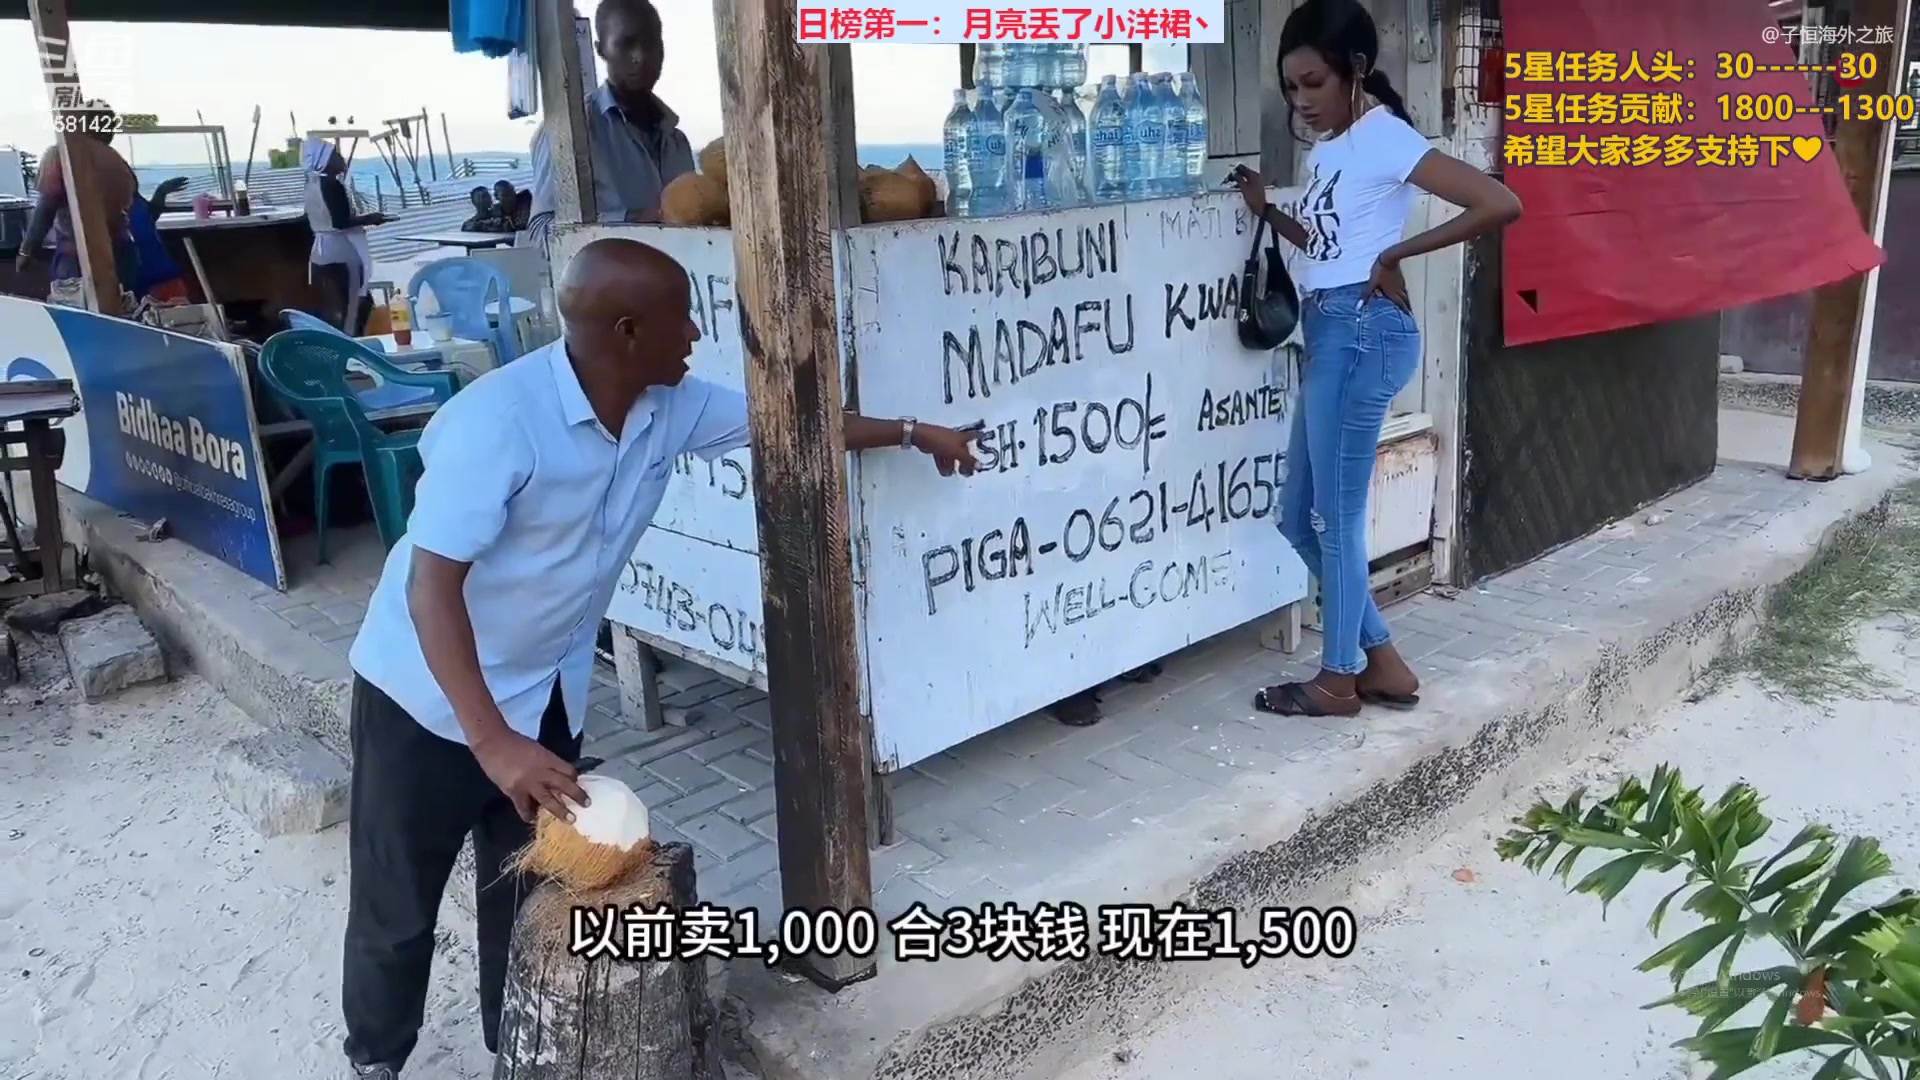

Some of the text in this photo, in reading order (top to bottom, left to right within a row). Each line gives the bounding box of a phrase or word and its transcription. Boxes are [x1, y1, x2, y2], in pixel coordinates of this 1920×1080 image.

[937, 218, 1118, 300] KARIBUNI
[942, 272, 1240, 405] MADAFU KWA
[115, 390, 248, 481] Bidhaa Bora
